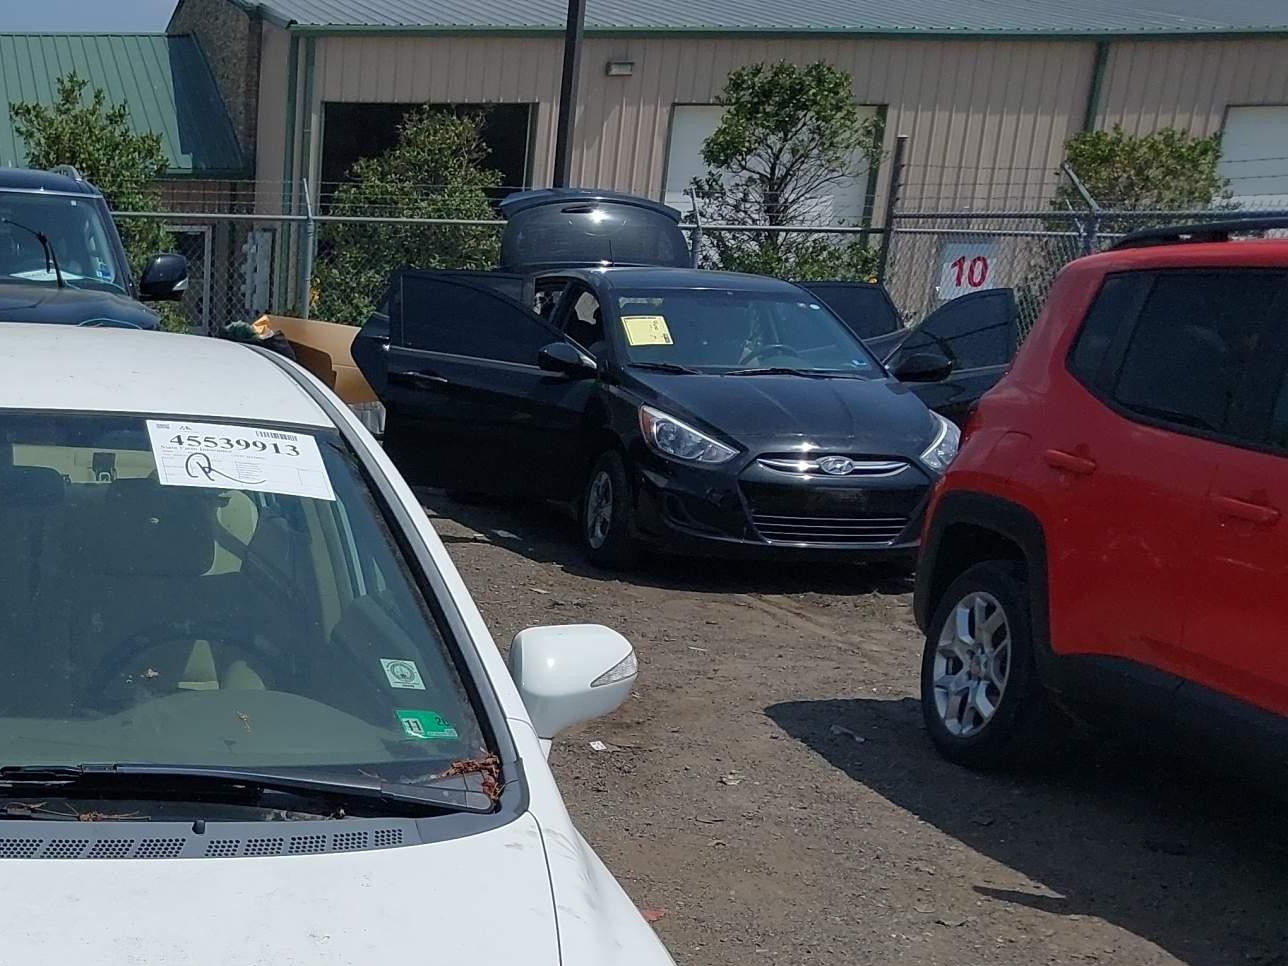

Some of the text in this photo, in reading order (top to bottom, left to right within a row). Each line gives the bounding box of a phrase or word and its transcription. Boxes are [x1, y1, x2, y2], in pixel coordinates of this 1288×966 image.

[951, 255, 988, 287] 10
[169, 434, 301, 457] 45539913
[405, 719, 421, 731] 11
